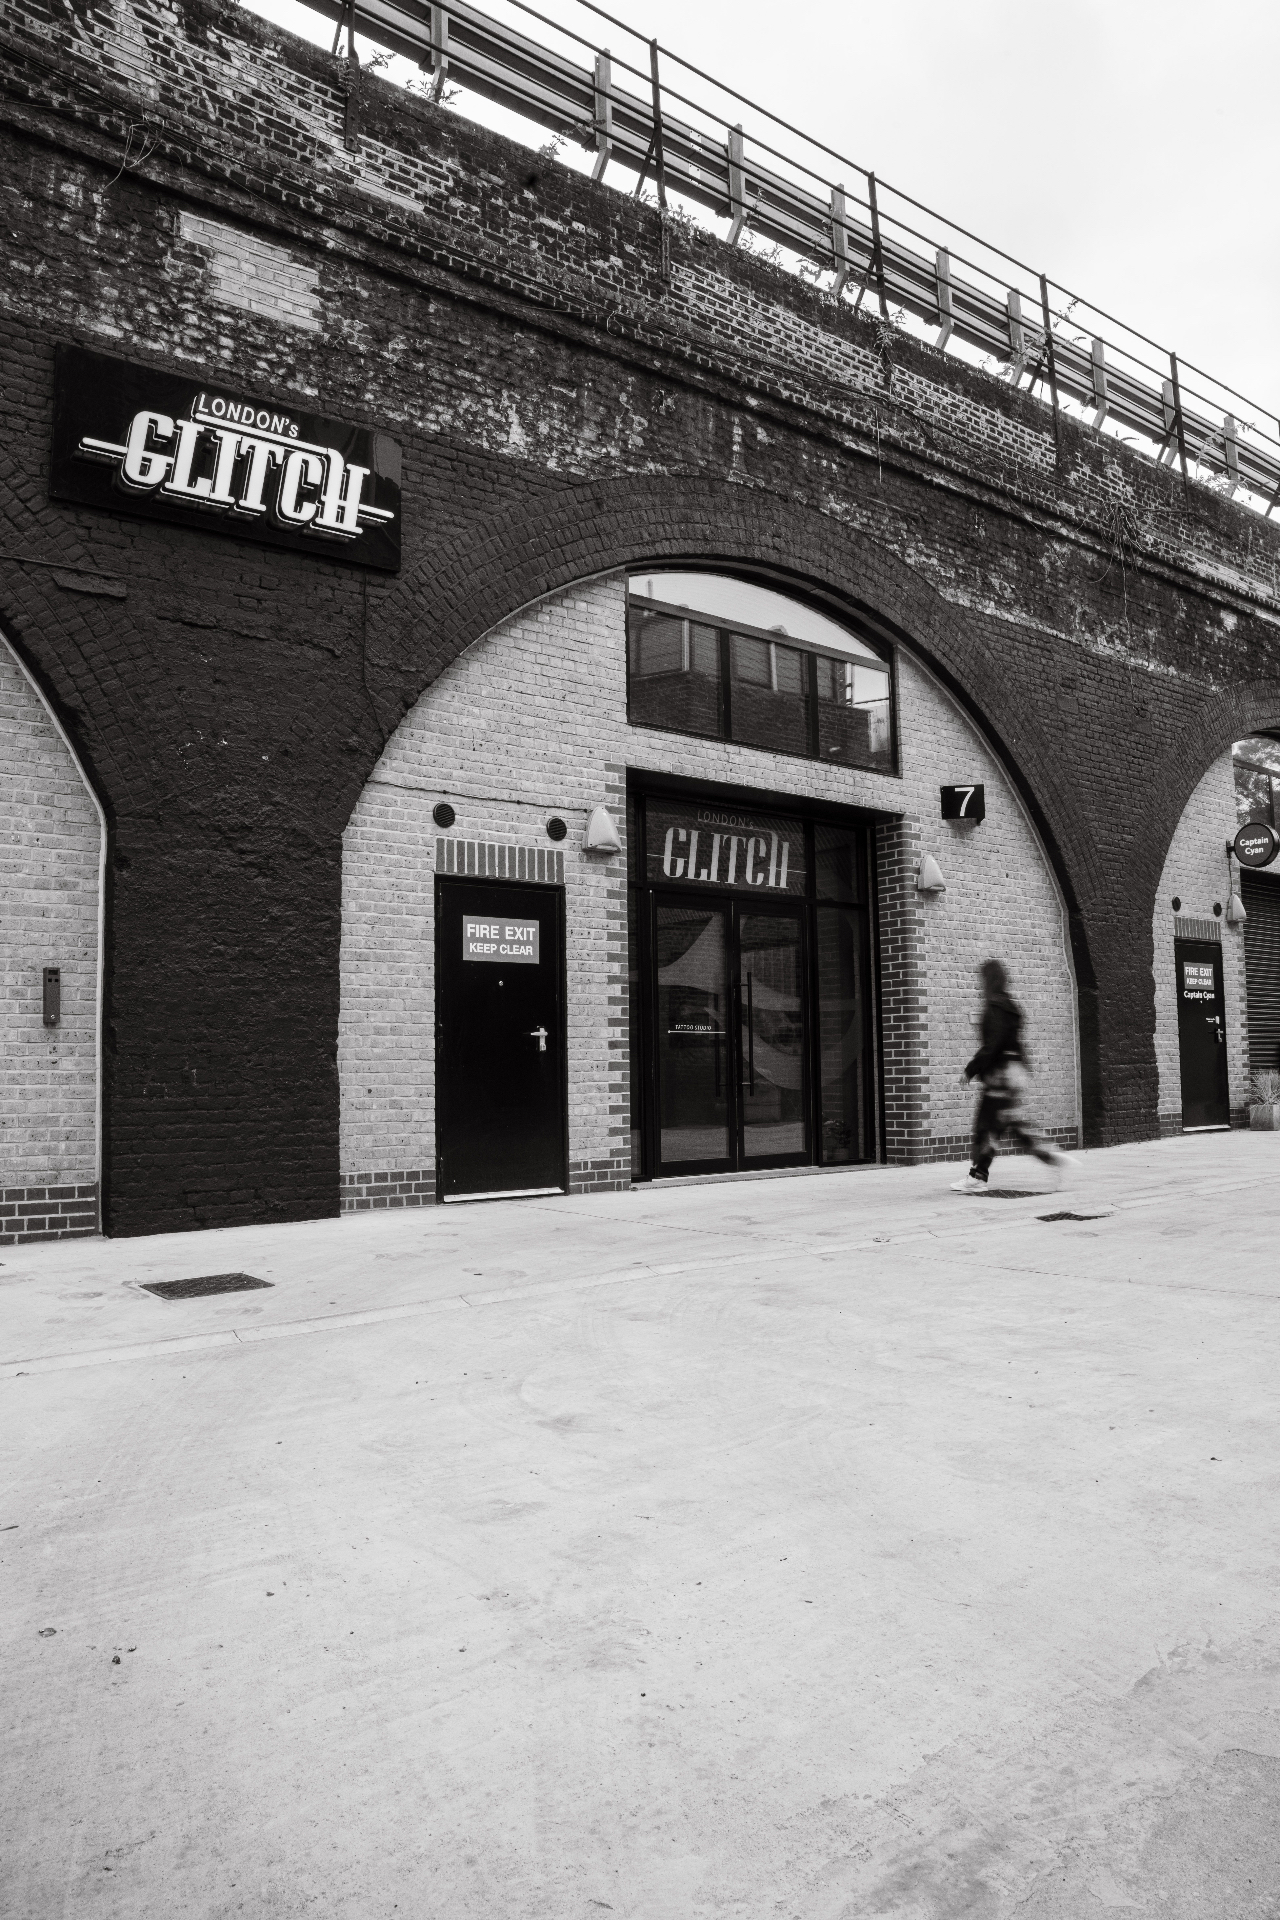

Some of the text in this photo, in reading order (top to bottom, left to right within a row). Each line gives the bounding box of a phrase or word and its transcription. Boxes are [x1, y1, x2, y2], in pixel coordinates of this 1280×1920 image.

[198, 394, 299, 438] LONDON's
[121, 410, 371, 537] GLITCH
[954, 786, 975, 817] 7
[697, 810, 754, 828] LONDON's
[1239, 836, 1269, 847] Captain
[663, 827, 790, 889] GLITCH
[1244, 847, 1264, 856] Cyan
[466, 923, 536, 941] FIRE EXIT
[469, 942, 533, 956] KEEP CLEAR
[1184, 966, 1213, 977] FIRE EXIT
[1186, 977, 1212, 986] KEEP CLEAR
[1183, 990, 1215, 1001] Captain Cyan
